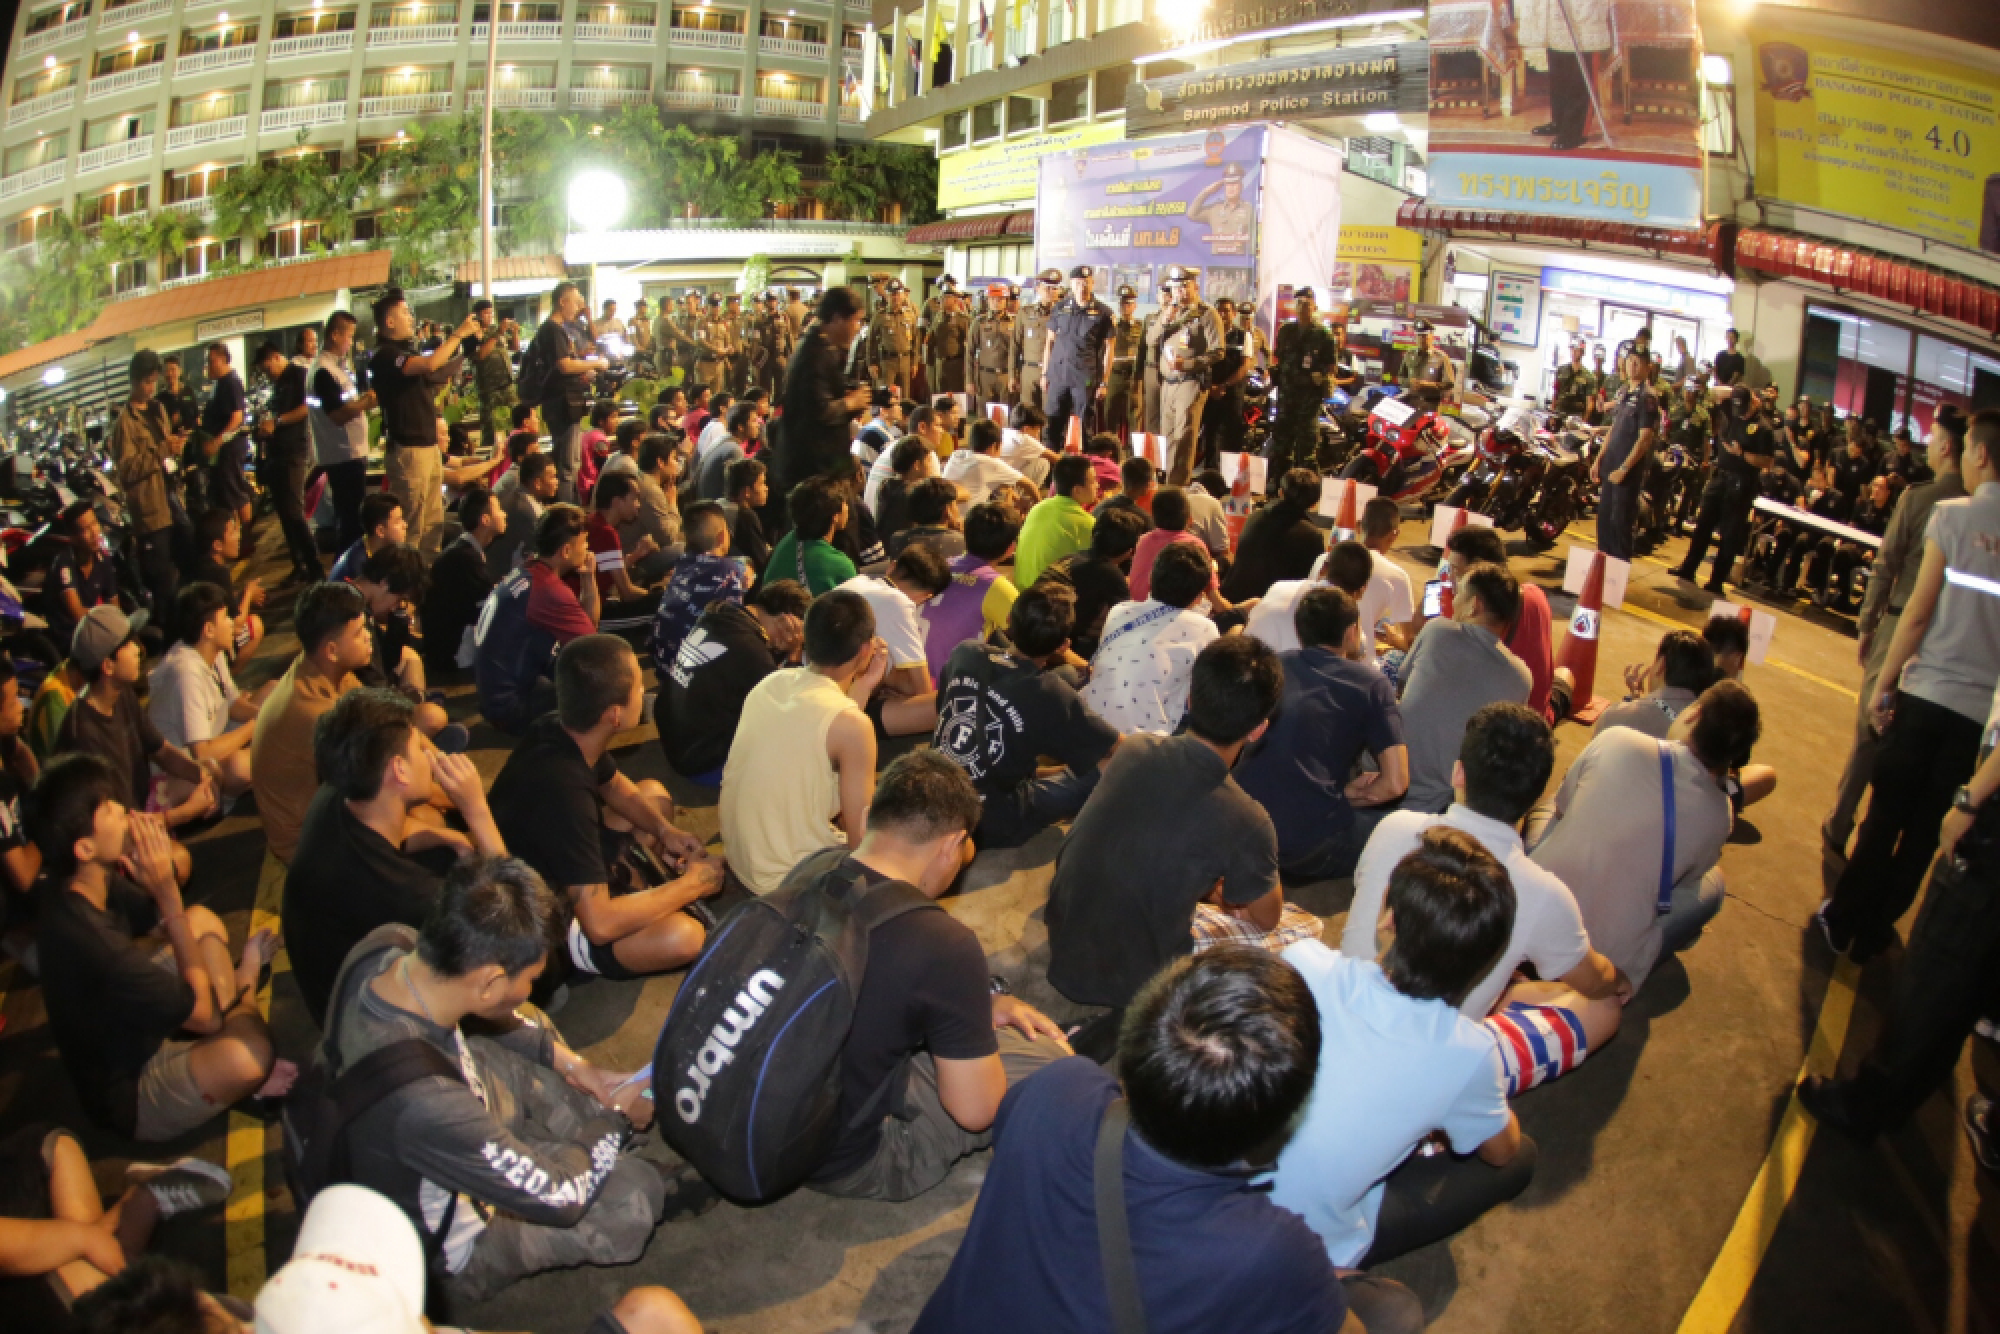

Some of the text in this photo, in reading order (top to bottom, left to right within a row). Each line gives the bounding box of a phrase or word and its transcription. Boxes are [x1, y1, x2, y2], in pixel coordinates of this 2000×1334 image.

[1177, 57, 1397, 98] สถานีตำรวจนครบาลบางมด
[1184, 88, 1389, 121] Bangmod Police Station
[1815, 77, 1995, 127] BANGMOD POLICE STATION
[1924, 124, 1972, 158] 4.0
[1458, 169, 1651, 219] ทรงพระเจริญ
[676, 968, 785, 1124] umbro
